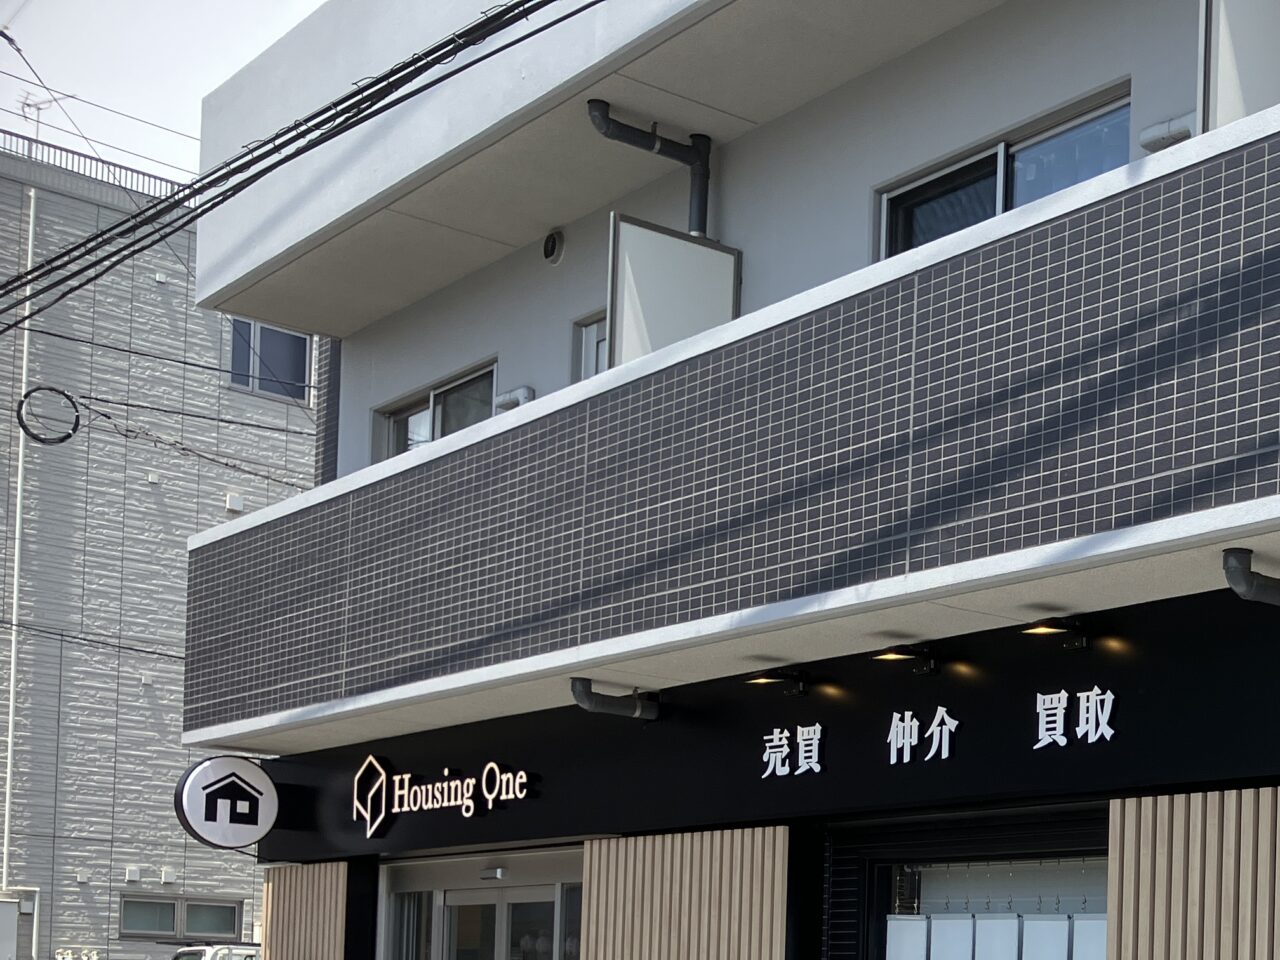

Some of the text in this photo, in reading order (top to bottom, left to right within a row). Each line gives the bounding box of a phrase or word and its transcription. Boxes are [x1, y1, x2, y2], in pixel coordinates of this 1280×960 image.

[761, 685, 1115, 779] 売買 仲介 買取
[391, 761, 528, 817] Housing One
